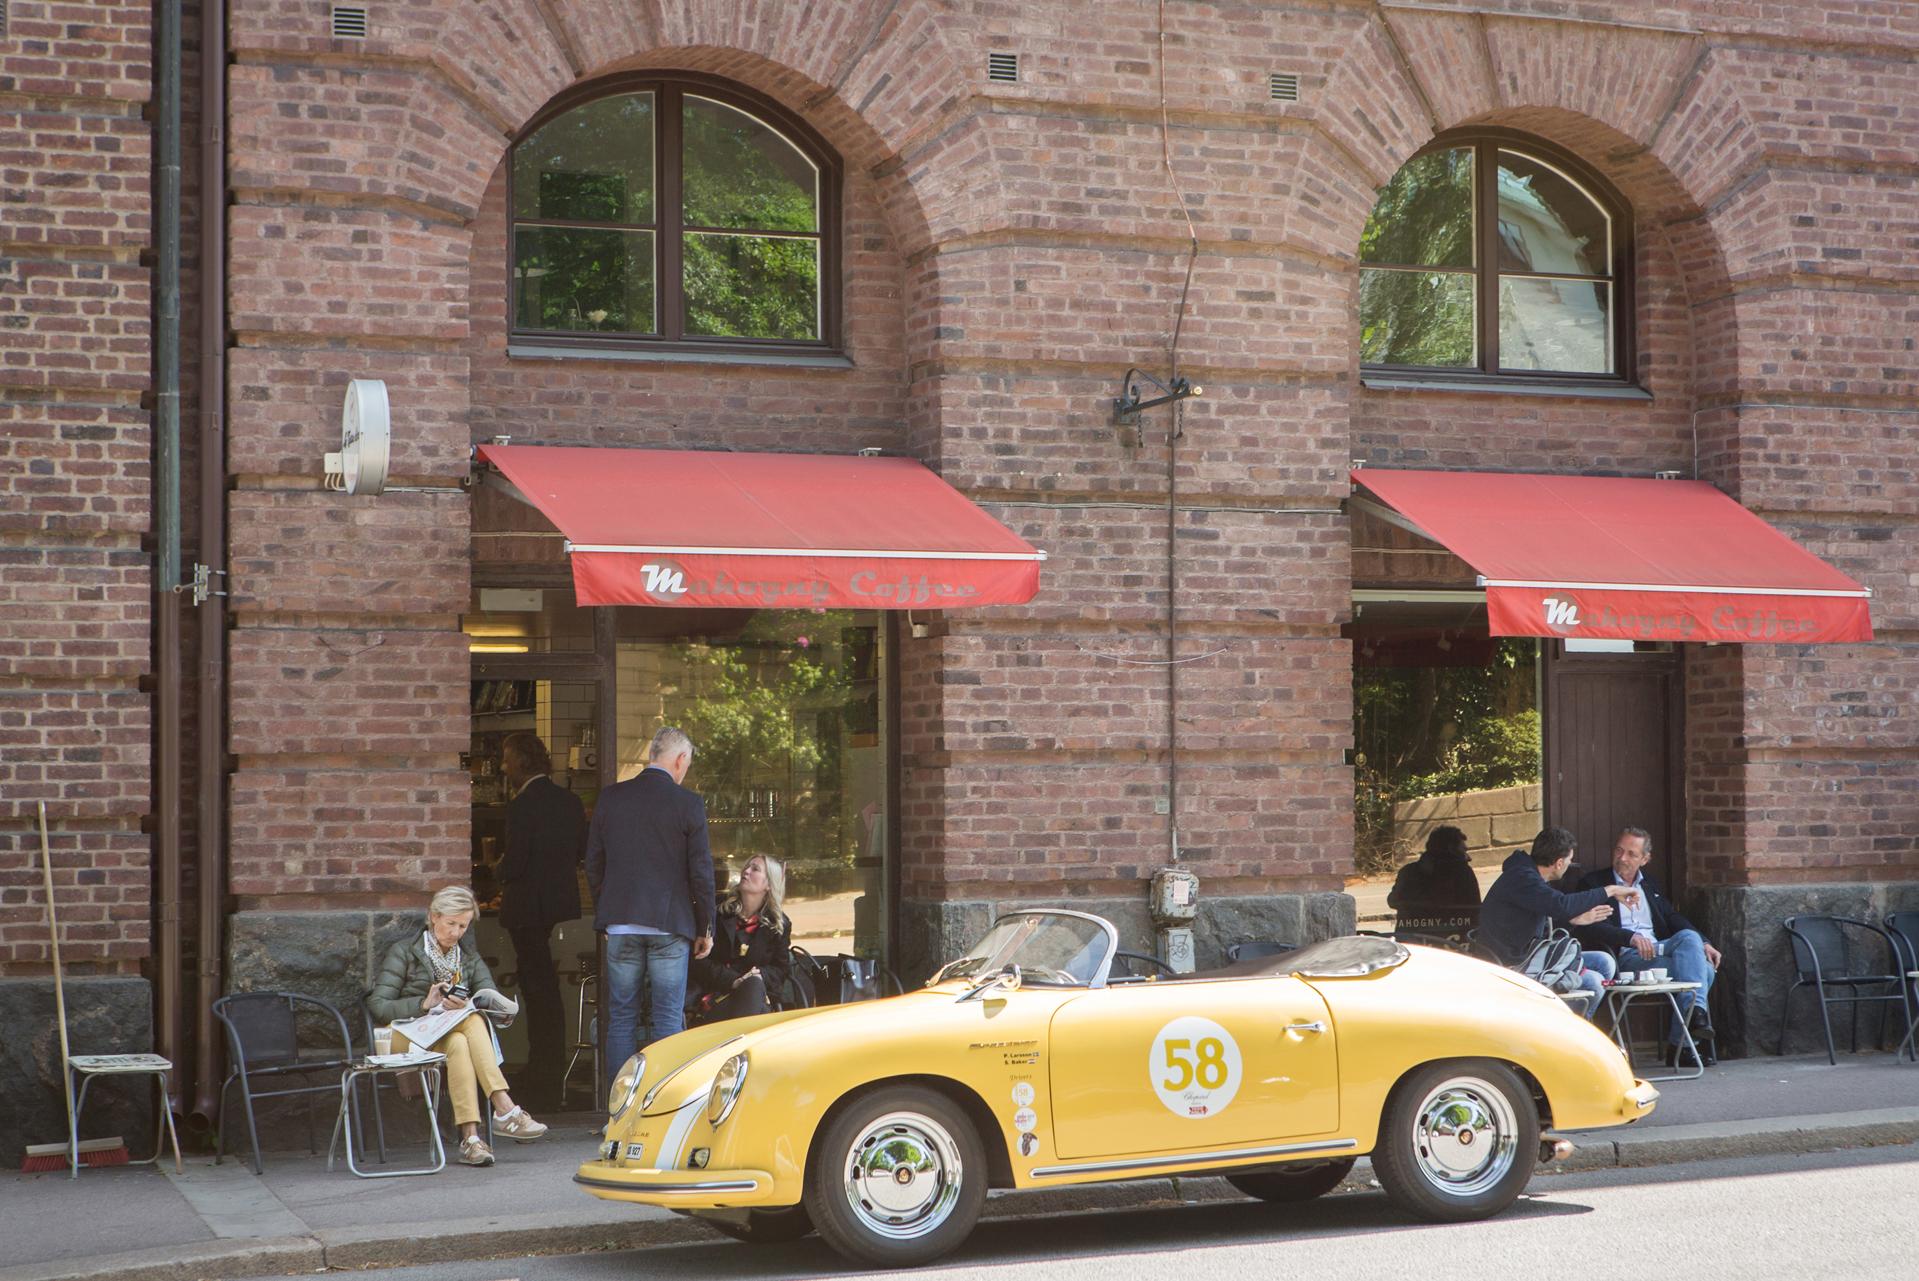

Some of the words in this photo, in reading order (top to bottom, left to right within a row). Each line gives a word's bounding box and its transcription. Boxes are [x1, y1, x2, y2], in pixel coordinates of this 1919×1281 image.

[640, 564, 832, 603] Mahogny
[850, 570, 982, 603] Coffee
[1543, 598, 1696, 636] Mahogny
[1712, 605, 1821, 638] Coffee
[1391, 917, 1471, 928] AHOGNY.COM
[1163, 1036, 1229, 1092] 58
